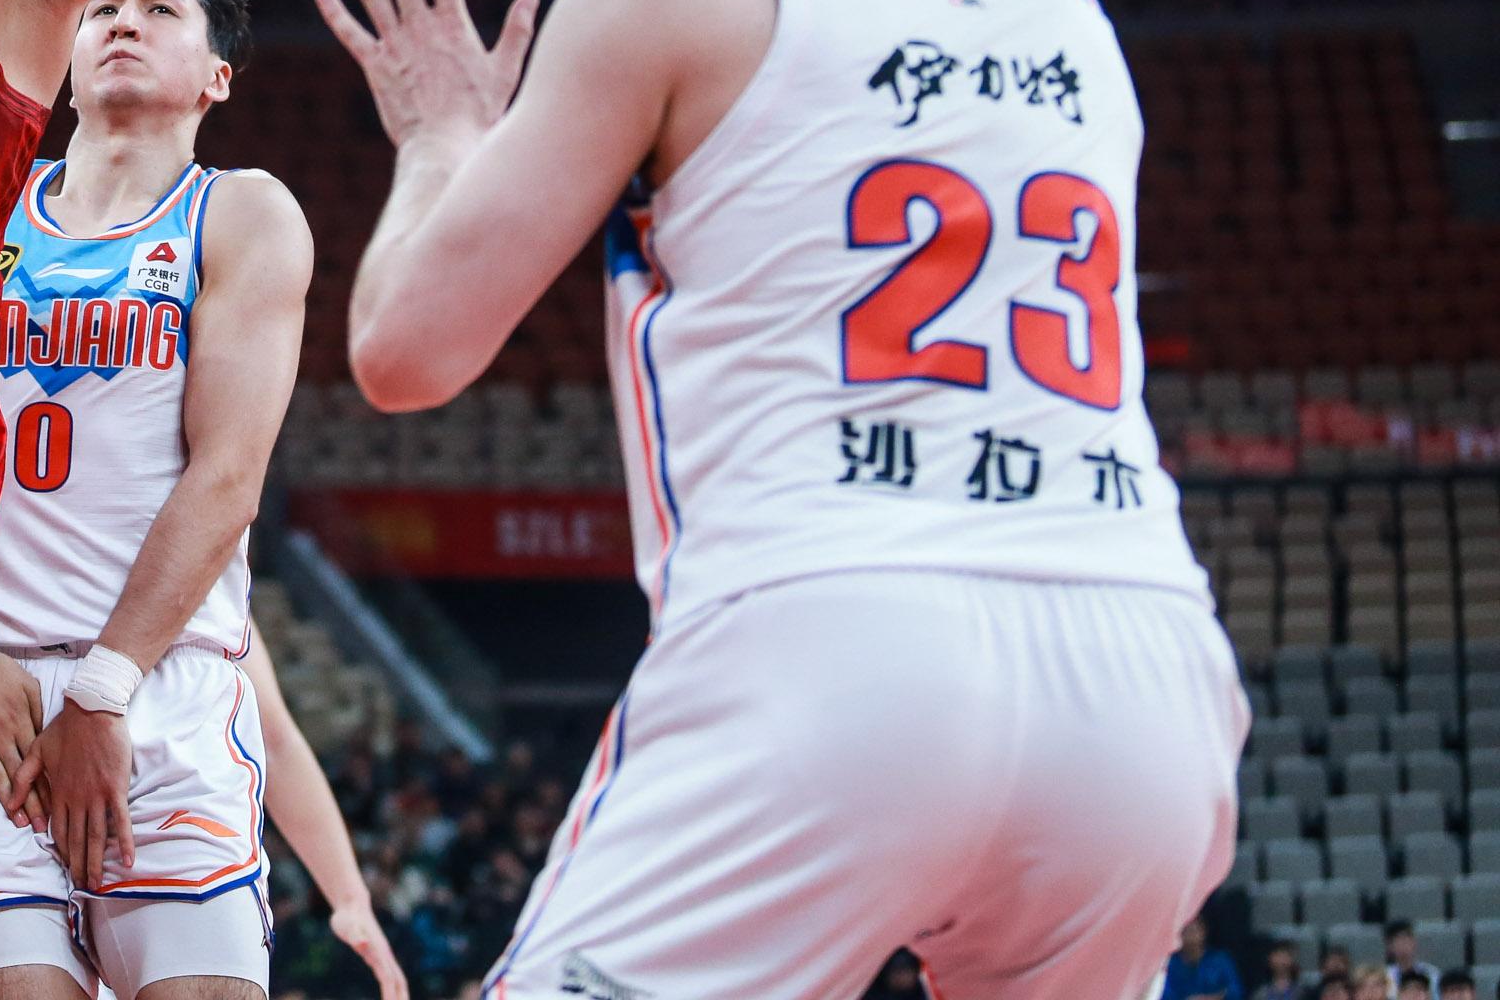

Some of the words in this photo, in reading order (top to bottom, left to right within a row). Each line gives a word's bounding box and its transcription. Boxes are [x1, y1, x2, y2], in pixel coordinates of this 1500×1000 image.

[137, 266, 181, 283] 广发银行
[144, 278, 170, 292] CGB
[839, 159, 1122, 412] 23
[14, 401, 74, 493] 0
